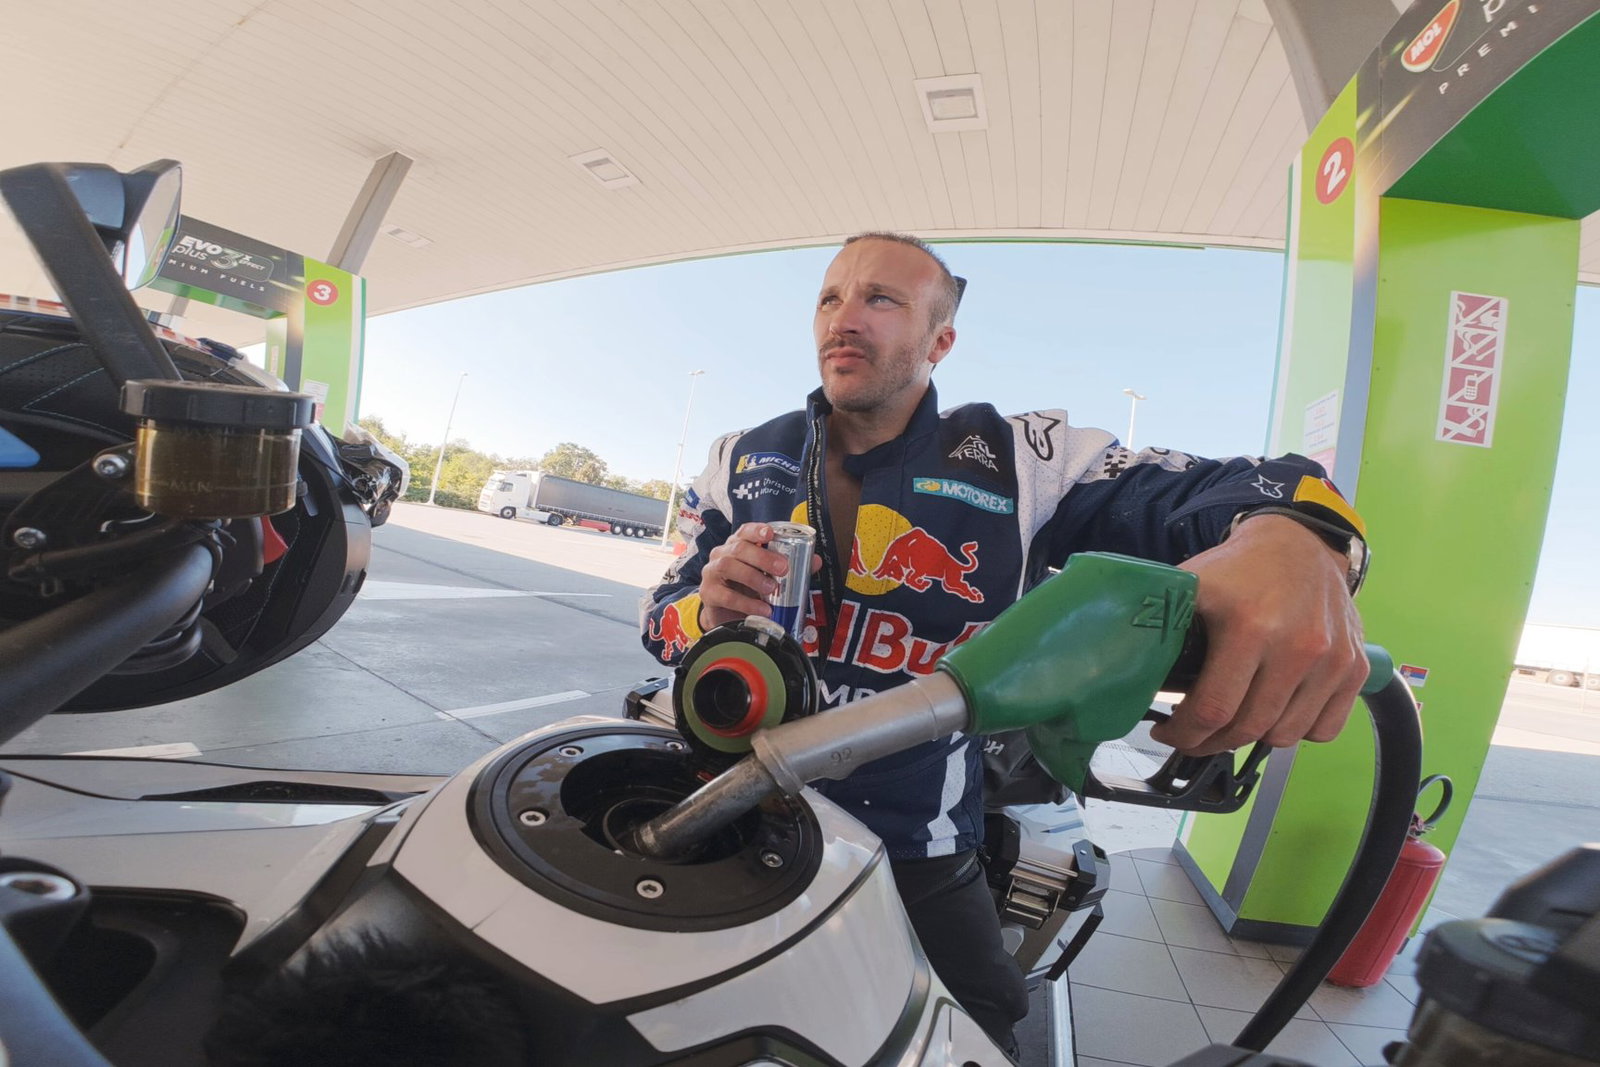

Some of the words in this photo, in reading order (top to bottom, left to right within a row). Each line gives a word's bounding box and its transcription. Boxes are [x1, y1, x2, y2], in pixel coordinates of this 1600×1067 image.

[1410, 21, 1443, 62] MOL
[1323, 151, 1347, 195] 2
[171, 245, 209, 261] plus
[179, 235, 223, 255] EVO
[219, 273, 265, 292] FUELS
[313, 284, 332, 301] 3
[942, 481, 1007, 512] MOTOREX
